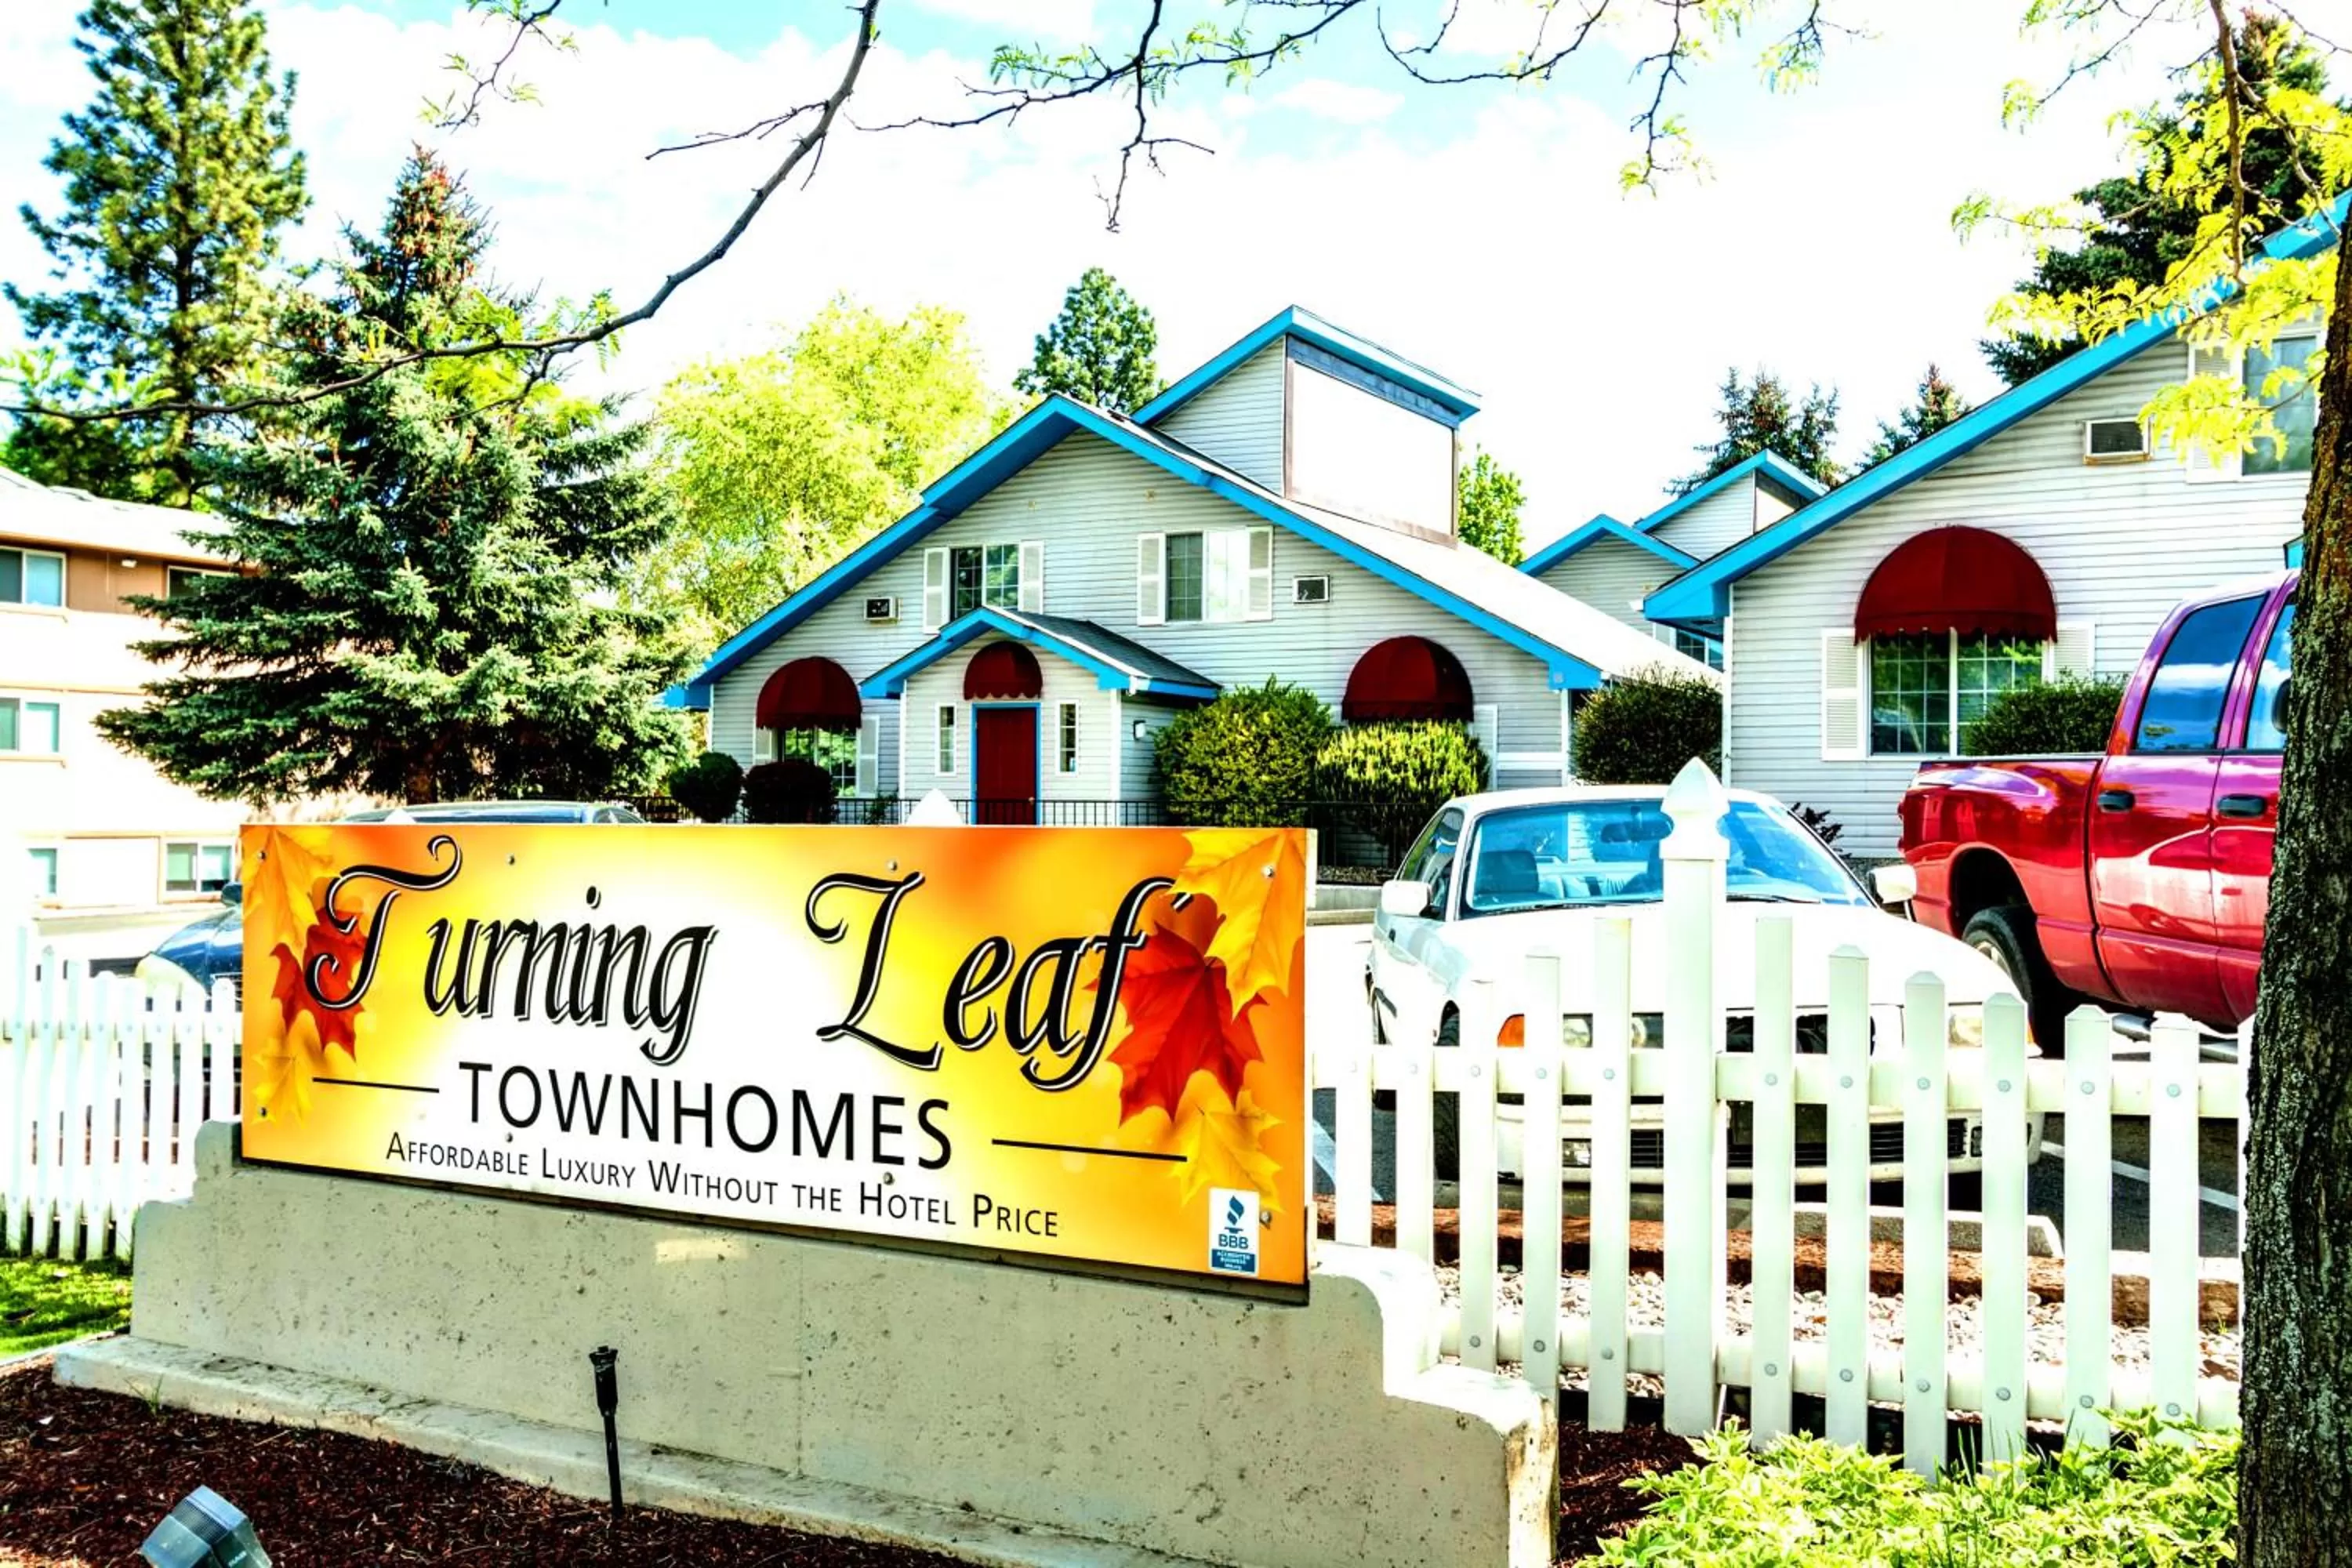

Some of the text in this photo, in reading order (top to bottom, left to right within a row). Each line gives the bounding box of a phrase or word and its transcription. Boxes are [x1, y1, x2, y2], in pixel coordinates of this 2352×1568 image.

[304, 834, 1196, 1093] Turning Leaf
[459, 1061, 953, 1171] TOWNHOMES
[1218, 1233, 1249, 1250] BBB
